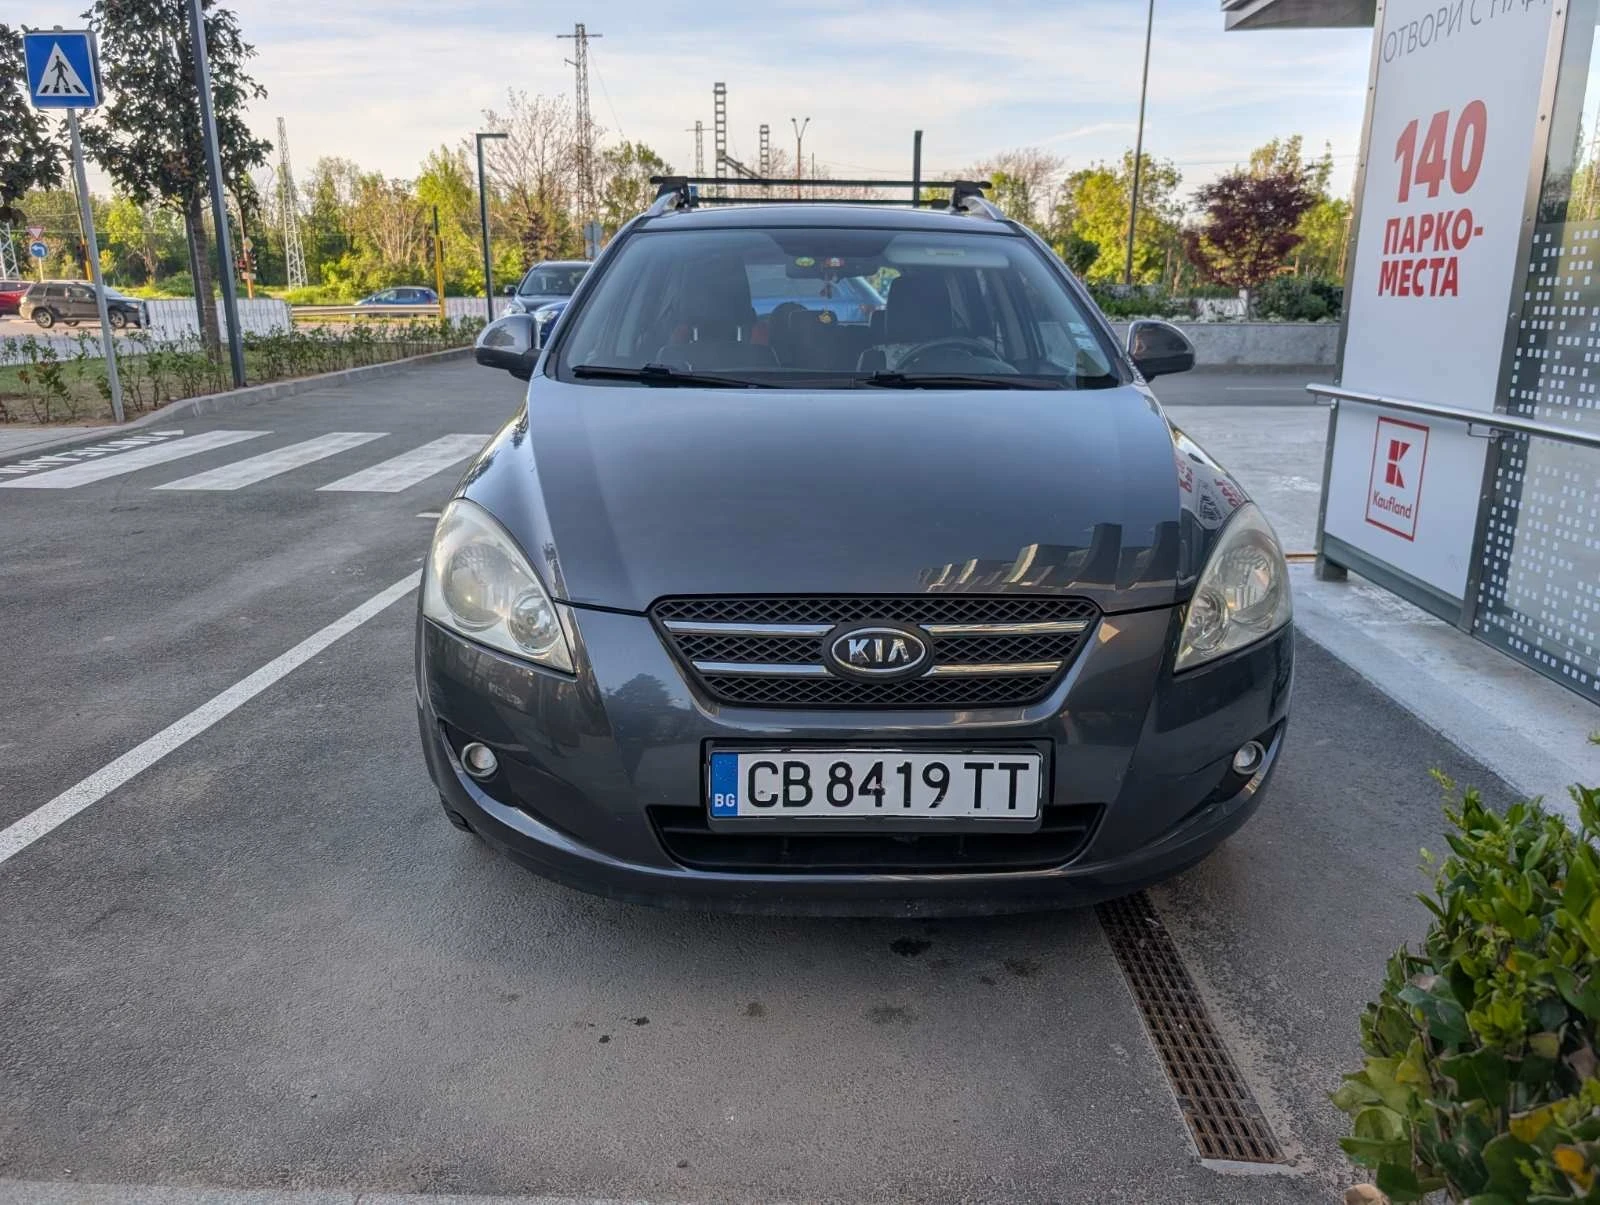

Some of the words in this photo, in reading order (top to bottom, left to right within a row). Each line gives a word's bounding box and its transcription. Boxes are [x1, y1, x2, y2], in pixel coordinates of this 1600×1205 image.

[1383, 0, 1465, 63] ОТВОРИ
[1394, 99, 1488, 203] 140
[1383, 208, 1484, 255] ПАРКО-
[1377, 256, 1459, 297] МЕСТА
[1372, 489, 1412, 519] Kaufland
[847, 638, 910, 663] KIA
[713, 793, 736, 808] BG
[748, 760, 814, 808] CB
[826, 760, 951, 808] 8419
[963, 762, 1030, 810] TT
